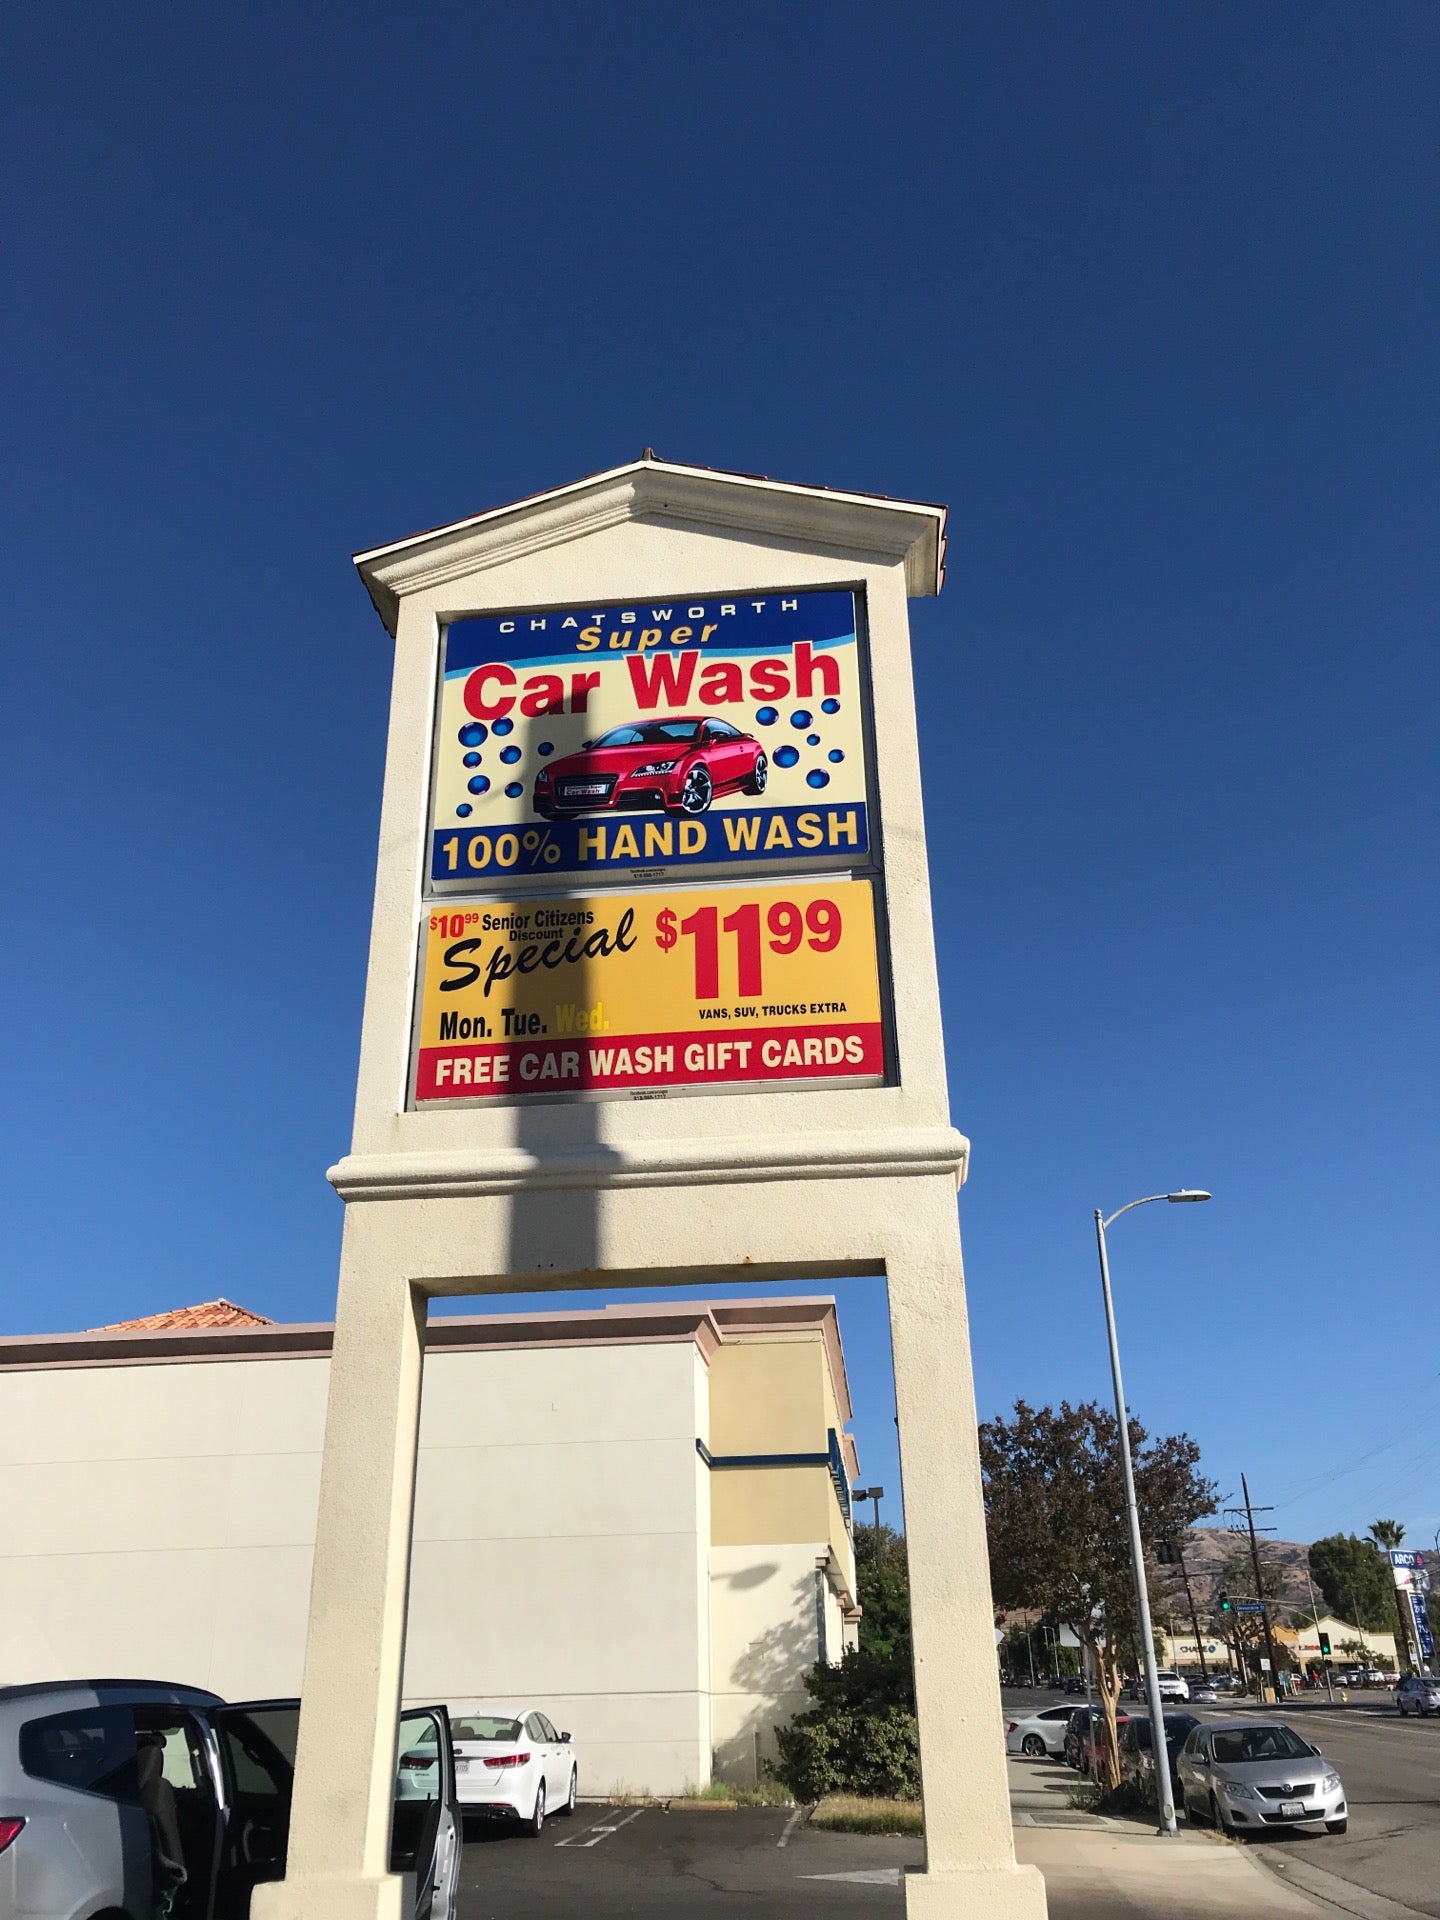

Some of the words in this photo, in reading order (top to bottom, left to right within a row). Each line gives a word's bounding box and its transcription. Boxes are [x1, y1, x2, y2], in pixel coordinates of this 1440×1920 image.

[499, 599, 798, 633] CHATSWORTH
[576, 621, 718, 652] Super
[463, 662, 601, 721] Car
[623, 641, 840, 709] Wash
[442, 829, 562, 871] 100%
[577, 820, 707, 862] HAND
[727, 811, 859, 851] WASH
[482, 912, 531, 931] Senior
[534, 909, 595, 928] Citizens
[508, 927, 564, 942] Discount
[439, 907, 638, 998] Special
[439, 1011, 493, 1040] Mon.
[501, 1008, 548, 1036] Tue.
[555, 1001, 609, 1033] Wed.
[699, 1008, 731, 1020] VANS,
[734, 1006, 759, 1019] SUV,
[762, 1004, 807, 1016] TRUCKS
[810, 1002, 847, 1014] EXTRA
[435, 1054, 510, 1087] FREE
[519, 1050, 581, 1080] CAR
[589, 1044, 675, 1077] WASH
[684, 1041, 753, 1072] GIFT
[761, 1035, 864, 1068] CARDS
[1394, 1553, 1415, 1566] ARCO
[1180, 1645, 1208, 1653] CHAE
